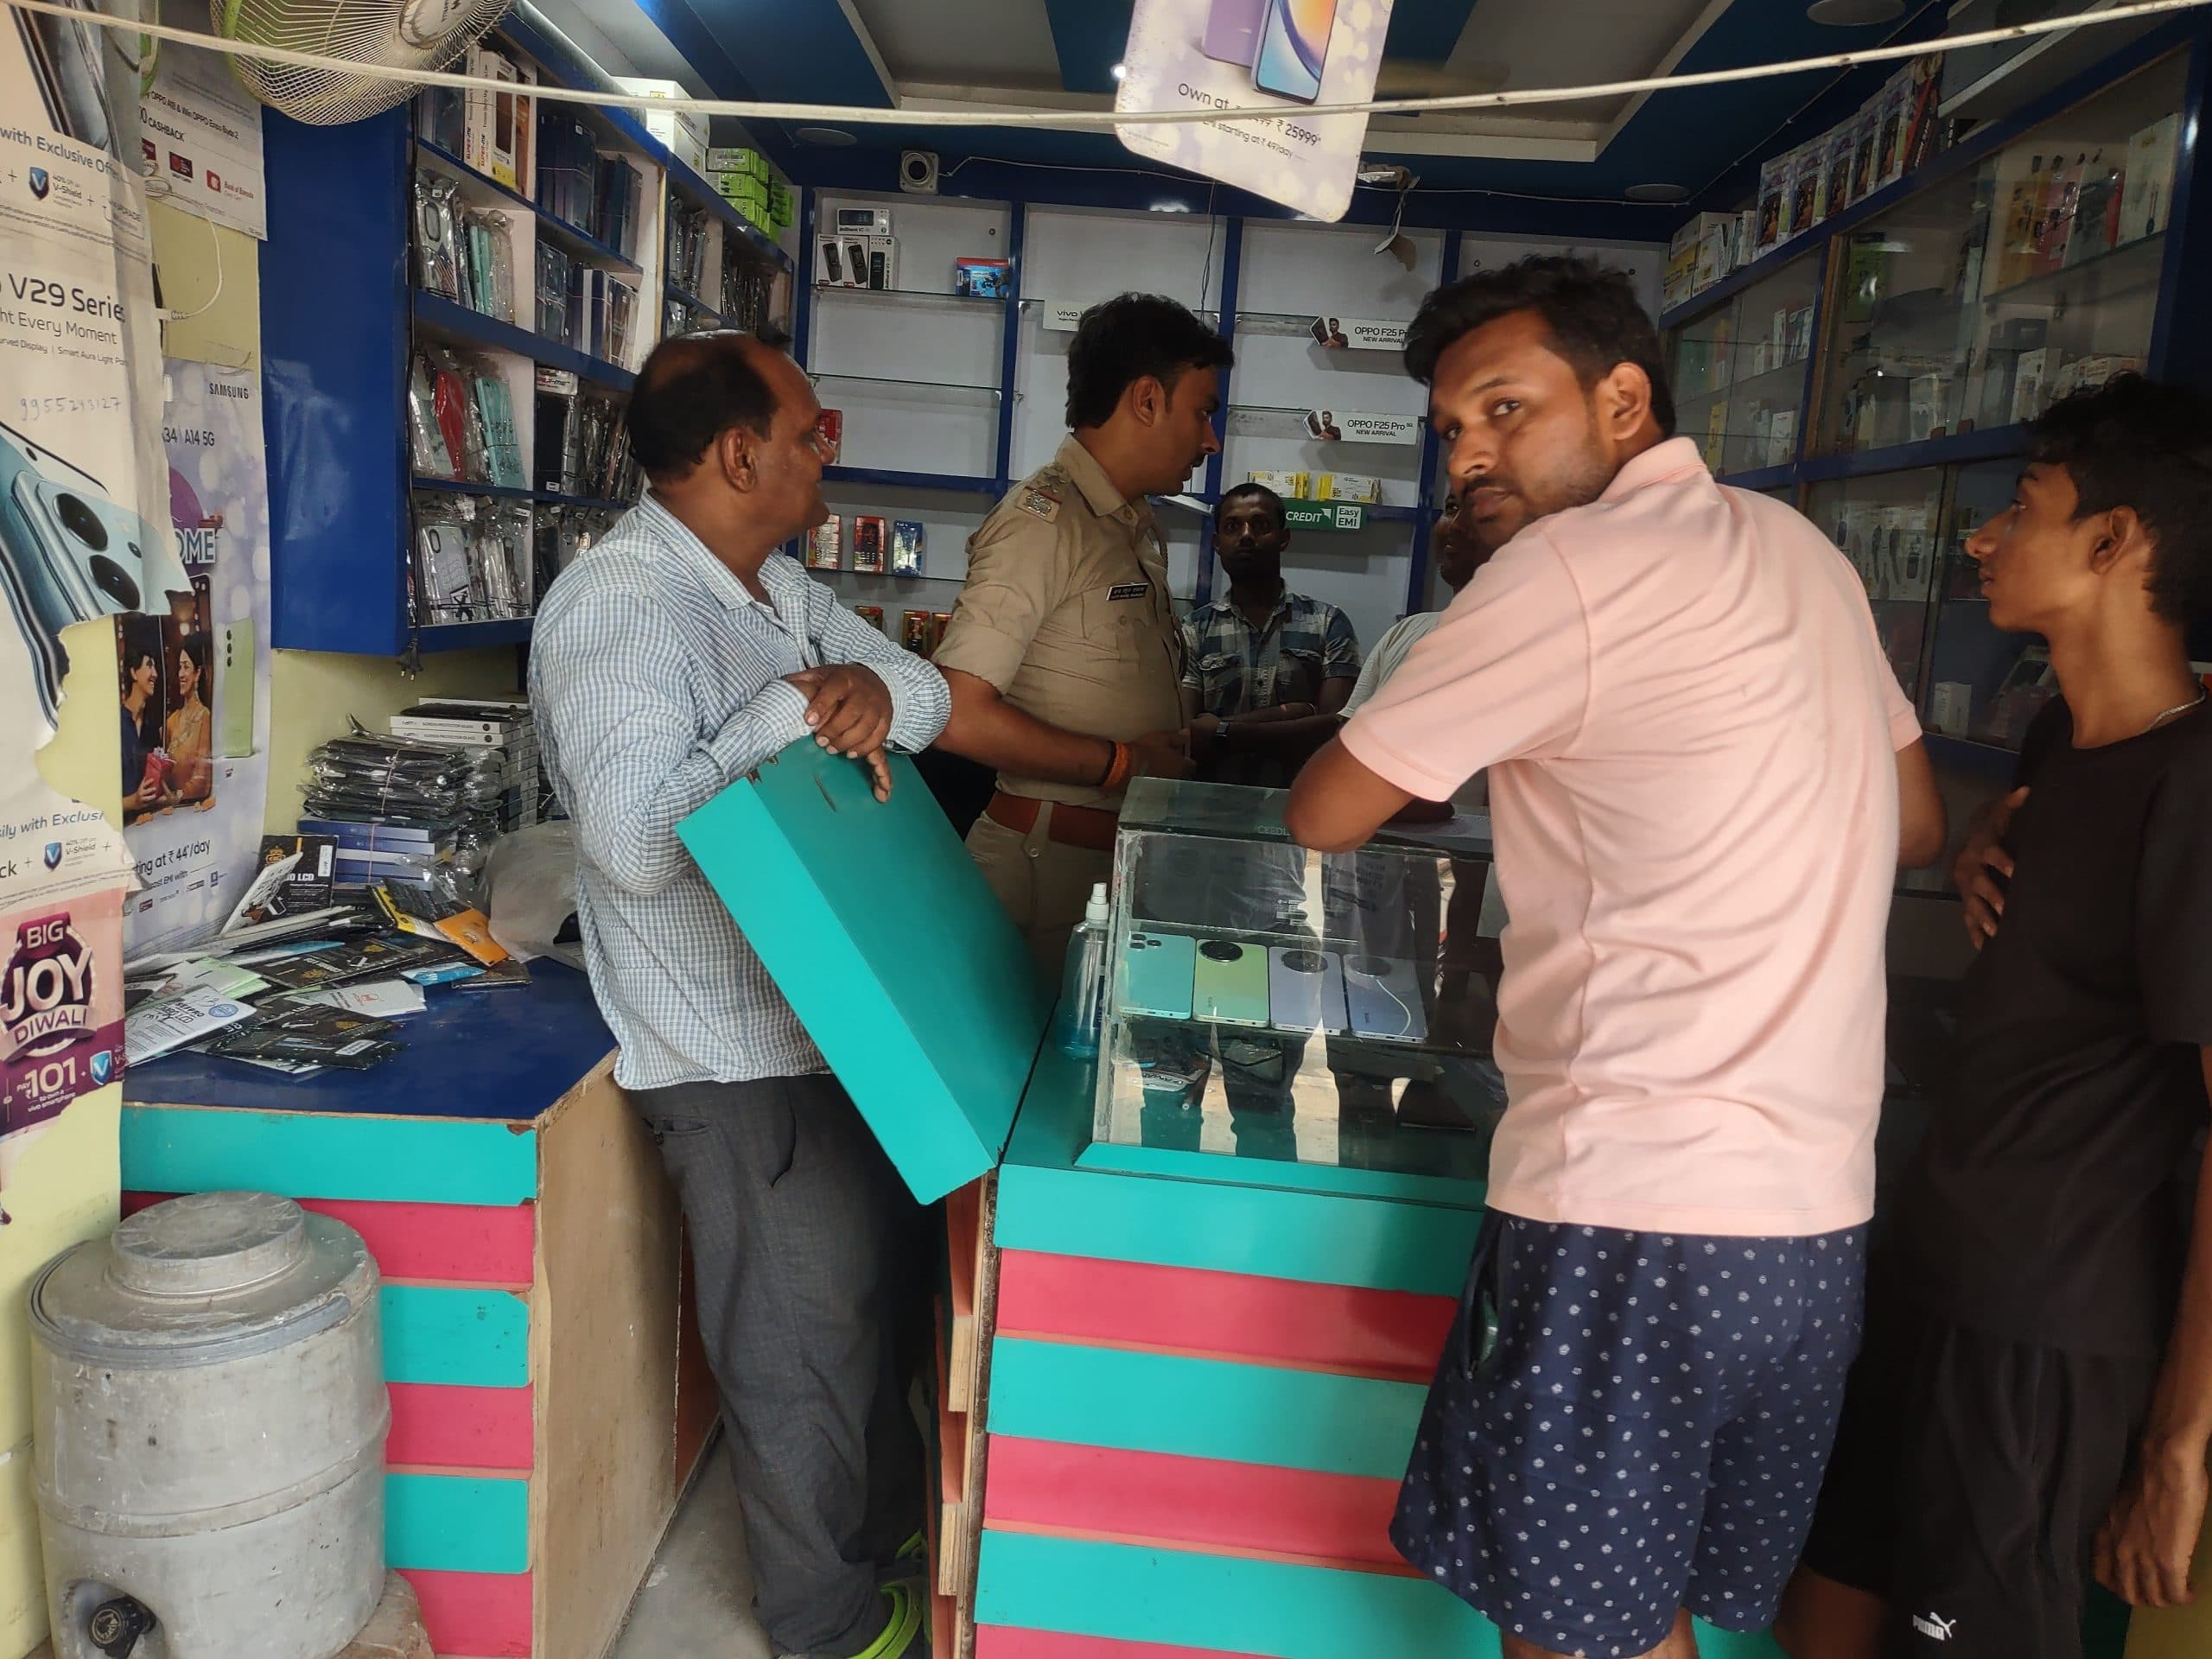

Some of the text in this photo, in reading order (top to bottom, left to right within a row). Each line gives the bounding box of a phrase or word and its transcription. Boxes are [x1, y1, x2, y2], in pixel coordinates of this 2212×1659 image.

[1179, 84, 1229, 110] Own at
[149, 117, 185, 143] CASHBACK
[1217, 124, 1249, 143] starting
[0, 128, 32, 146] with
[36, 136, 93, 168] Exclusive
[53, 182, 82, 199] V-Shield
[9, 273, 65, 307] V29
[18, 312, 62, 337] Every
[66, 321, 118, 345] Moment
[1354, 326, 1380, 336] OPPO
[1381, 328, 1398, 337] F25
[21, 340, 48, 353] Display
[58, 346, 79, 357] Smart
[208, 382, 250, 399] SAMSUNG
[1347, 419, 1373, 429] OPPO
[1374, 421, 1389, 429] F25
[1390, 422, 1406, 430] Pro
[1372, 429, 1397, 437] ARRIVAL
[163, 426, 215, 447] 34 A14 5G
[1285, 511, 1322, 522] CREDIT
[1338, 508, 1359, 517] Easy
[1338, 518, 1357, 526] EMI
[20, 816, 48, 833] with
[65, 842, 96, 855] V-Shield
[156, 854, 167, 868] at
[297, 873, 315, 881] LCD
[27, 920, 65, 950] BIG
[2, 947, 93, 1022] JOY
[14, 1014, 86, 1045] DIWALI
[25, 1057, 76, 1098] 101
